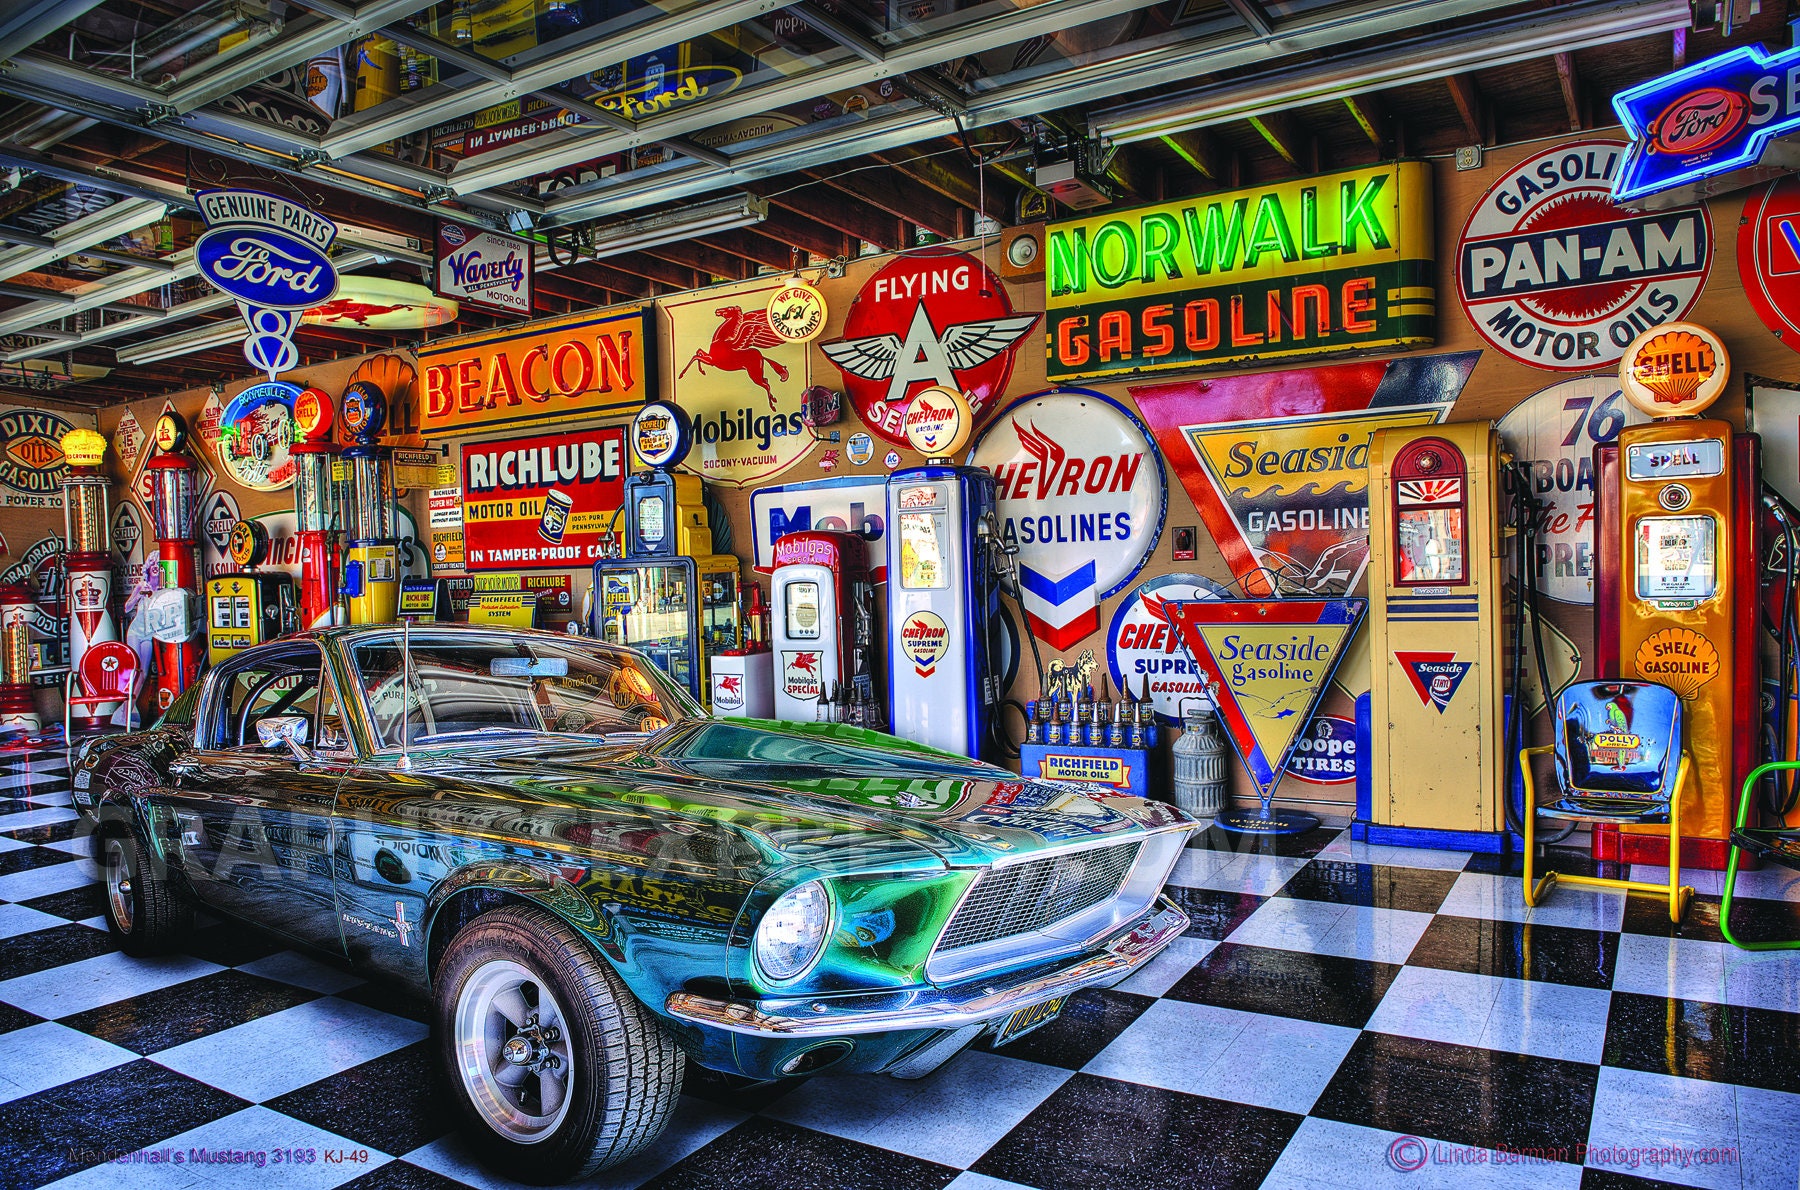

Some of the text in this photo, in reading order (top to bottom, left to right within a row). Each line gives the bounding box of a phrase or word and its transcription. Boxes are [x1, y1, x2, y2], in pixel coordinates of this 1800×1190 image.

[595, 76, 708, 119] Ford
[1668, 97, 1731, 144] Ford
[1495, 151, 1617, 216] GASOLI
[206, 196, 330, 243] GENUINE PARTS
[1050, 173, 1391, 297] NORWALK
[506, 240, 521, 251] 1880
[1470, 217, 1696, 294] PAN-AM
[213, 237, 323, 294] Ford
[448, 250, 525, 292] Waverly
[467, 284, 479, 292] ALL
[874, 265, 969, 303] FLYING
[486, 290, 528, 307] MOTOR OIL
[777, 289, 812, 304] WE GIVE
[772, 310, 820, 337] GREEN STAMPS
[1057, 276, 1377, 367] GASOLINE
[1486, 287, 1680, 361] MOTOR OILS
[1639, 350, 1710, 378] SHELL
[426, 330, 635, 419] BEACON
[809, 391, 840, 416] RPM
[296, 407, 315, 418] SHELL
[906, 404, 956, 425] CHEVRON
[1560, 389, 1626, 447] 76
[1, 413, 70, 440] DIXIE
[639, 418, 667, 431] RICHFIELD
[691, 407, 803, 450] Mobilgas
[123, 434, 134, 448] 15
[203, 429, 222, 440] CAUTIO
[20, 440, 54, 464] OILS
[398, 452, 430, 460] RICHFIELD
[1223, 432, 1375, 479] Seasid
[467, 439, 620, 492] RICHLUBE
[703, 455, 777, 469] SOCONY-VACUUM
[1650, 454, 1701, 468] SHELL
[433, 488, 458, 496] RICHLUBE
[6, 496, 62, 506] POWER TO
[429, 500, 446, 508] SUPER
[468, 500, 542, 520] MOTOR OIL
[571, 513, 604, 523] 100% PURE
[208, 519, 233, 533] SKELLY
[571, 521, 614, 531] PENNSYLVAN
[1002, 511, 1132, 545] ASOLINES
[1248, 508, 1370, 532] GASOLINE
[113, 527, 136, 539] SKELLY
[432, 532, 463, 542] RICHFIELD
[470, 549, 484, 562] IN
[487, 545, 582, 562] TAMPER-PROOF
[776, 537, 832, 557] Mobilgas
[786, 556, 820, 564] SPECIAL
[205, 562, 240, 579] GASOLIN
[475, 575, 519, 591] STOP YOUR MOTOR
[527, 577, 566, 588] RICHLUBE
[405, 594, 430, 602] RICHLUBE
[902, 624, 947, 640] CHEVRON
[1117, 623, 1190, 655] CHEV
[907, 639, 943, 647] SUPREME
[1218, 635, 1330, 662] Seaside
[1653, 641, 1697, 658] SHELL
[1134, 658, 1199, 675] SUPRE
[1232, 661, 1314, 687] gasoline
[1418, 663, 1463, 673] Seaside
[1643, 660, 1710, 674] GASOLINE
[787, 676, 818, 686] Mobilgas
[787, 684, 820, 695] SPECIAL
[1433, 679, 1449, 688] ETHYL
[715, 695, 742, 705] Mobiloil
[1599, 734, 1637, 746] POLLY
[1049, 757, 1119, 771] RICHFIELD
[1292, 755, 1356, 774] TIRES
[1057, 769, 1110, 779] MOTOR OILS
[341, 913, 399, 939] MUSTANG
